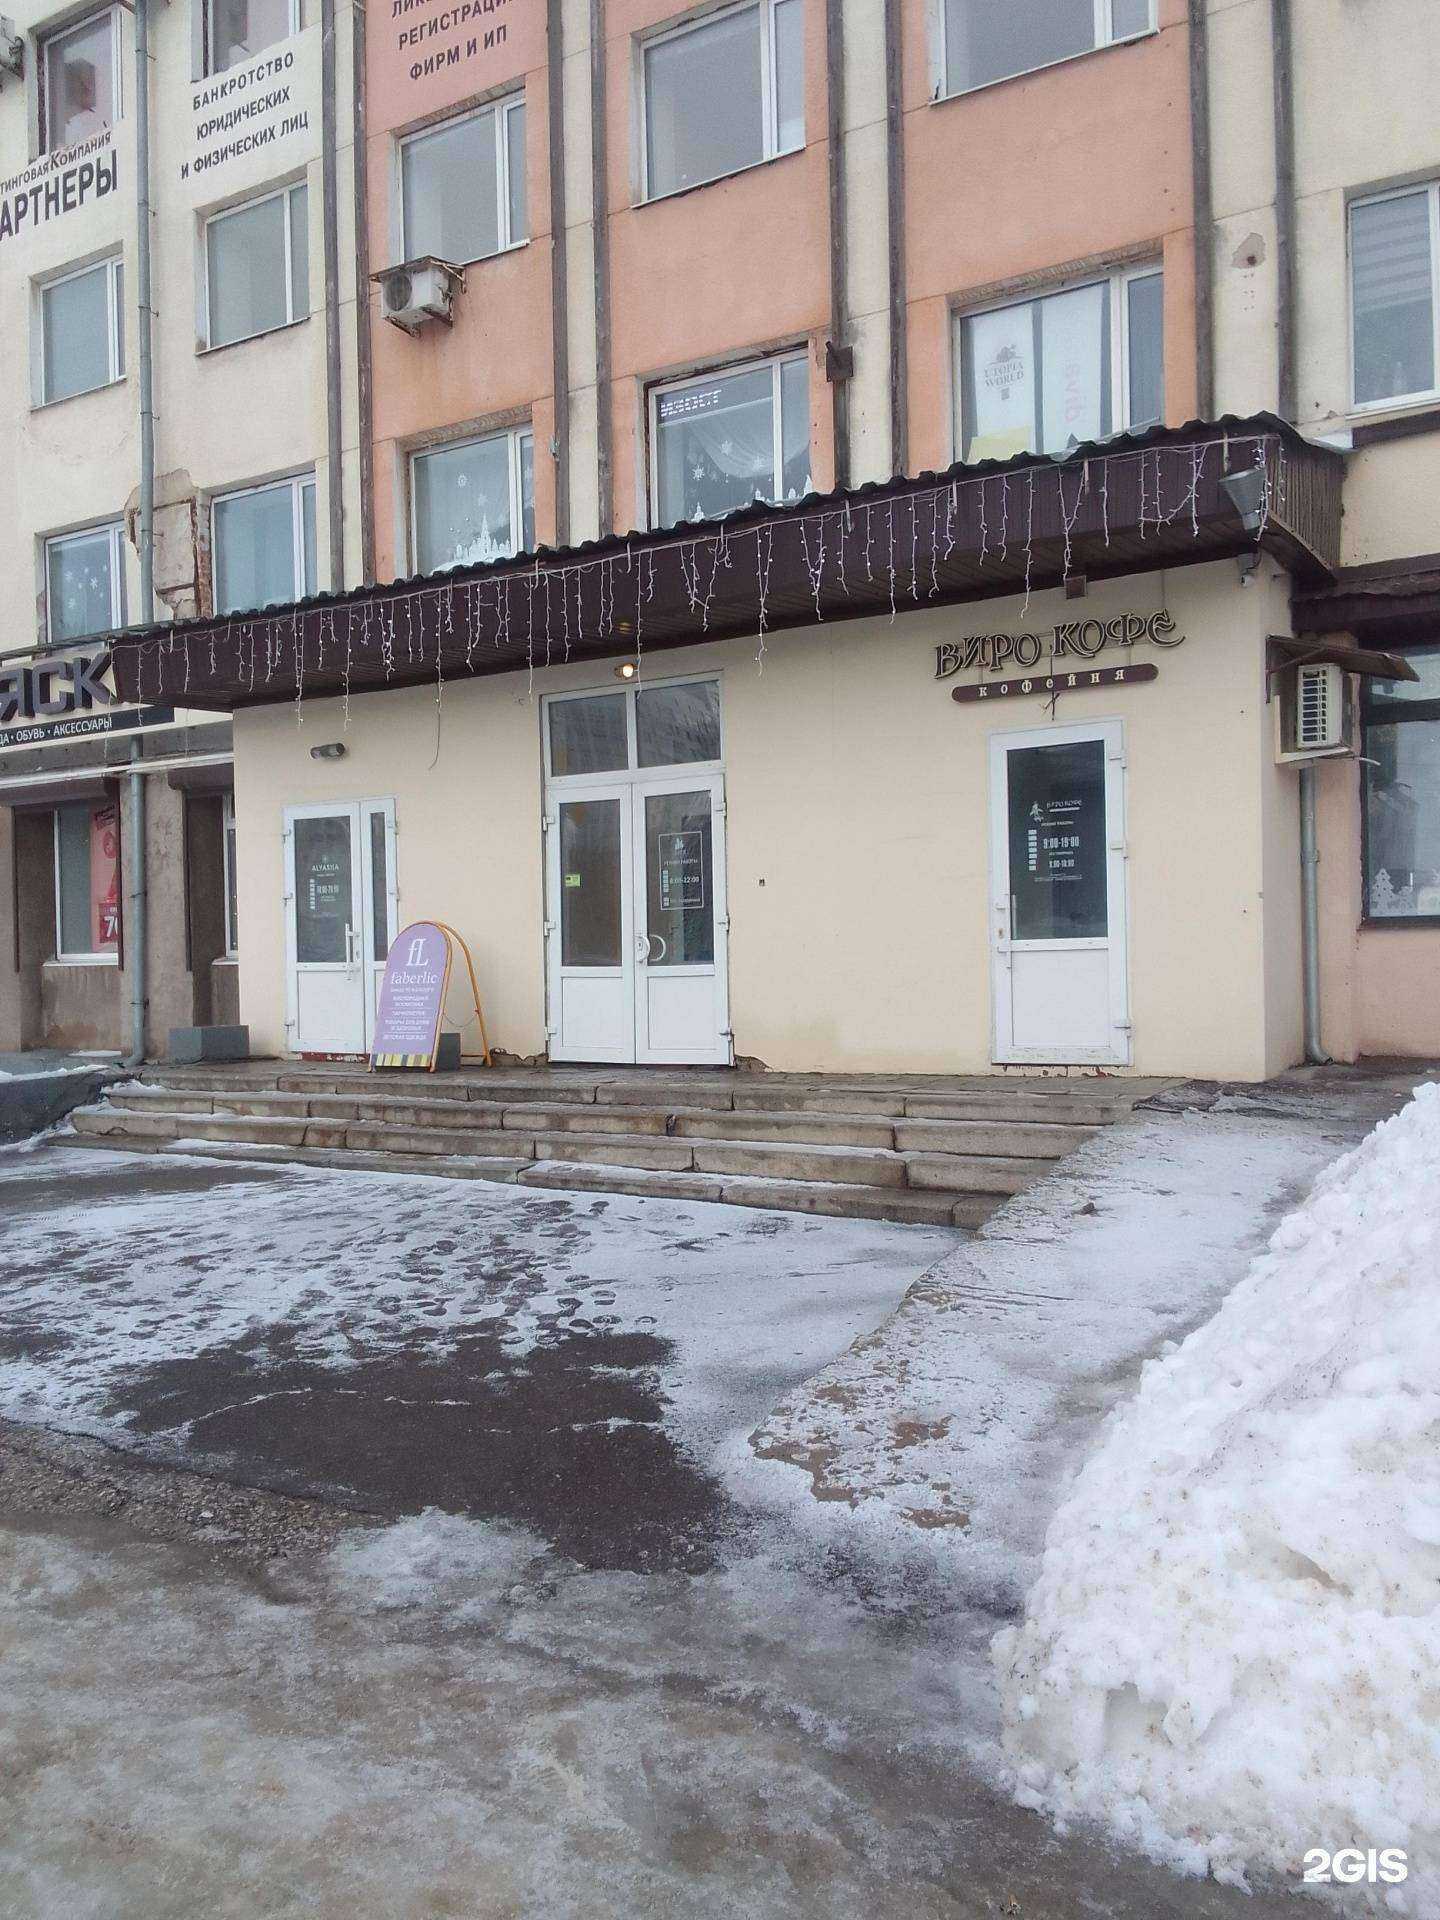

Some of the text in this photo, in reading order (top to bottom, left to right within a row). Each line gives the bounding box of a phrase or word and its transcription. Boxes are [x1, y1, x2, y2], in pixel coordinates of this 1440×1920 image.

[410, 24, 507, 80] ФИРМ И ИП
[193, 52, 294, 111] БАНКРОТСТВО
[196, 85, 291, 140] ЮРИДИЧЕСКИХ
[181, 111, 309, 180] И ФИЗИЧЕСКИХ ЛИЦ
[934, 607, 1187, 680] ВИРО КОФЕ
[16, 728, 45, 742] ОБУВЬ
[53, 716, 113, 737] АКСЕССУАРЫ
[391, 971, 440, 985] faberlic
